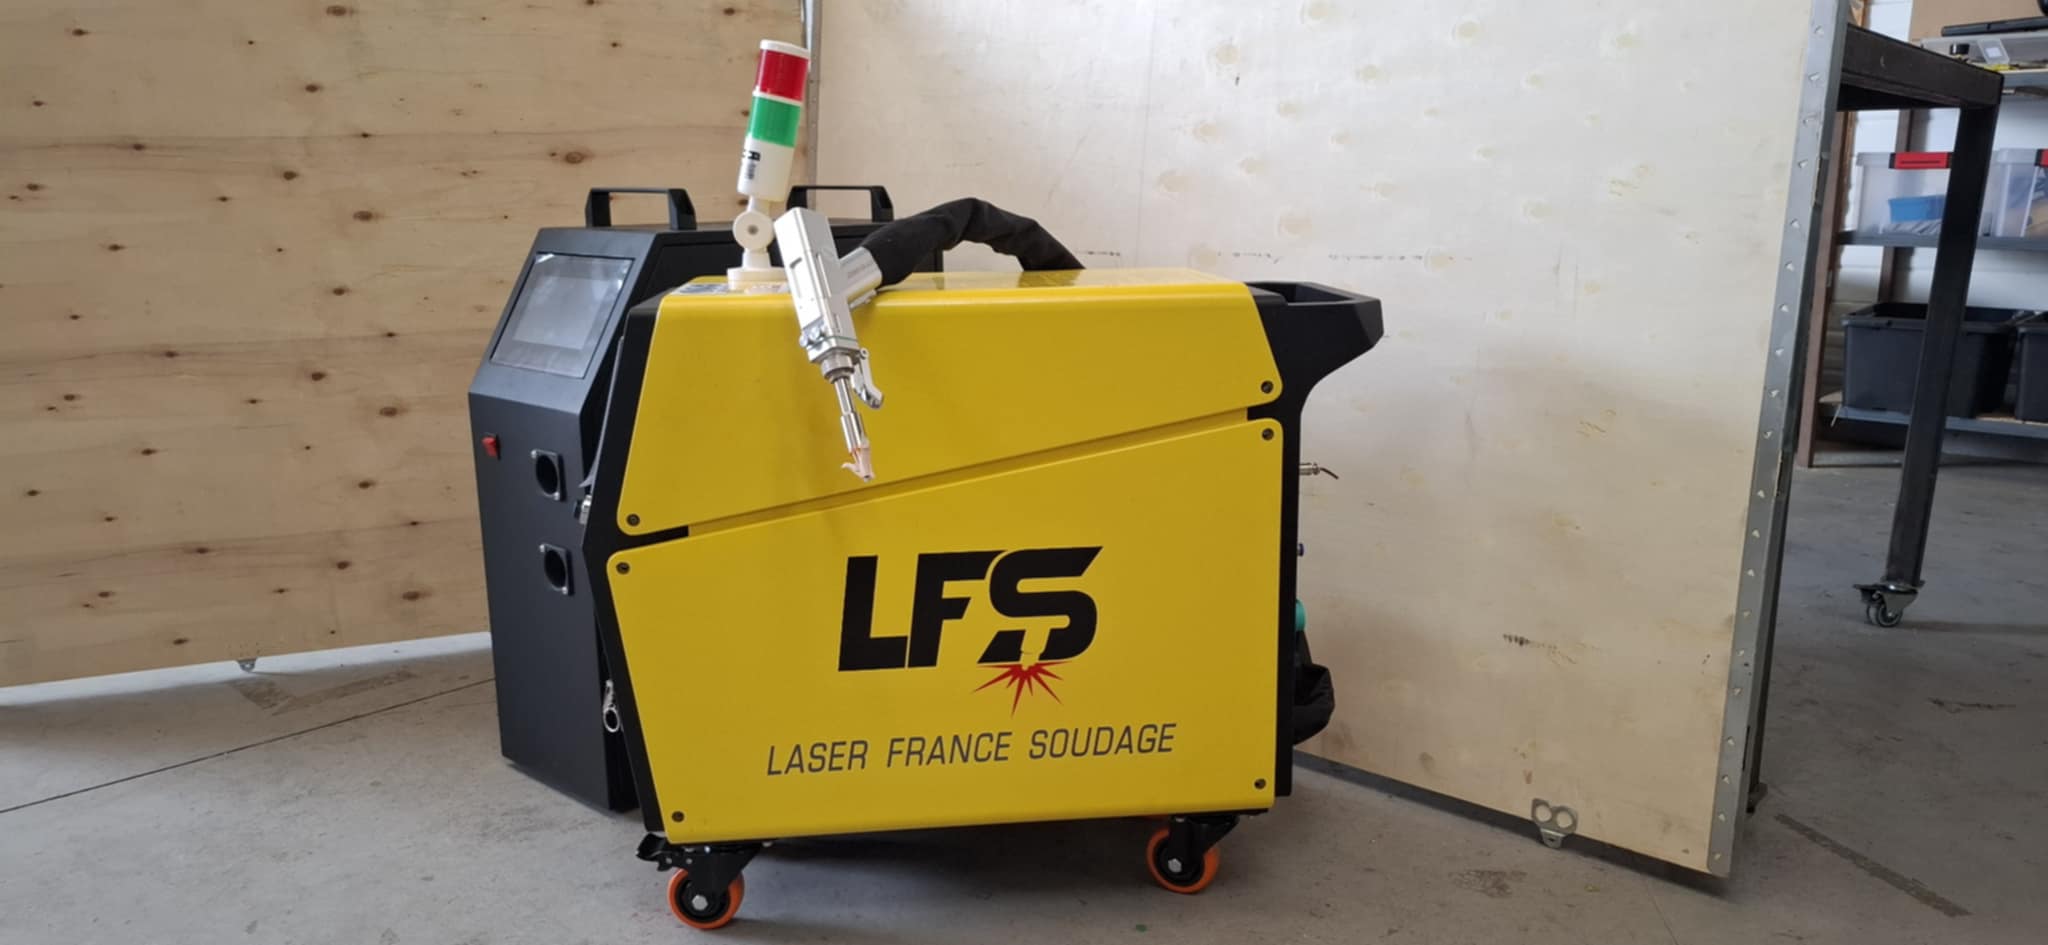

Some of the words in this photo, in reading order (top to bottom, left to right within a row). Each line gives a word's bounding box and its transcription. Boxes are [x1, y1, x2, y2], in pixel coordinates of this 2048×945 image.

[838, 546, 1103, 672] LFS
[767, 740, 868, 775] LASER
[887, 732, 1012, 767] FRANCE
[1029, 724, 1176, 759] SOUDAGE
